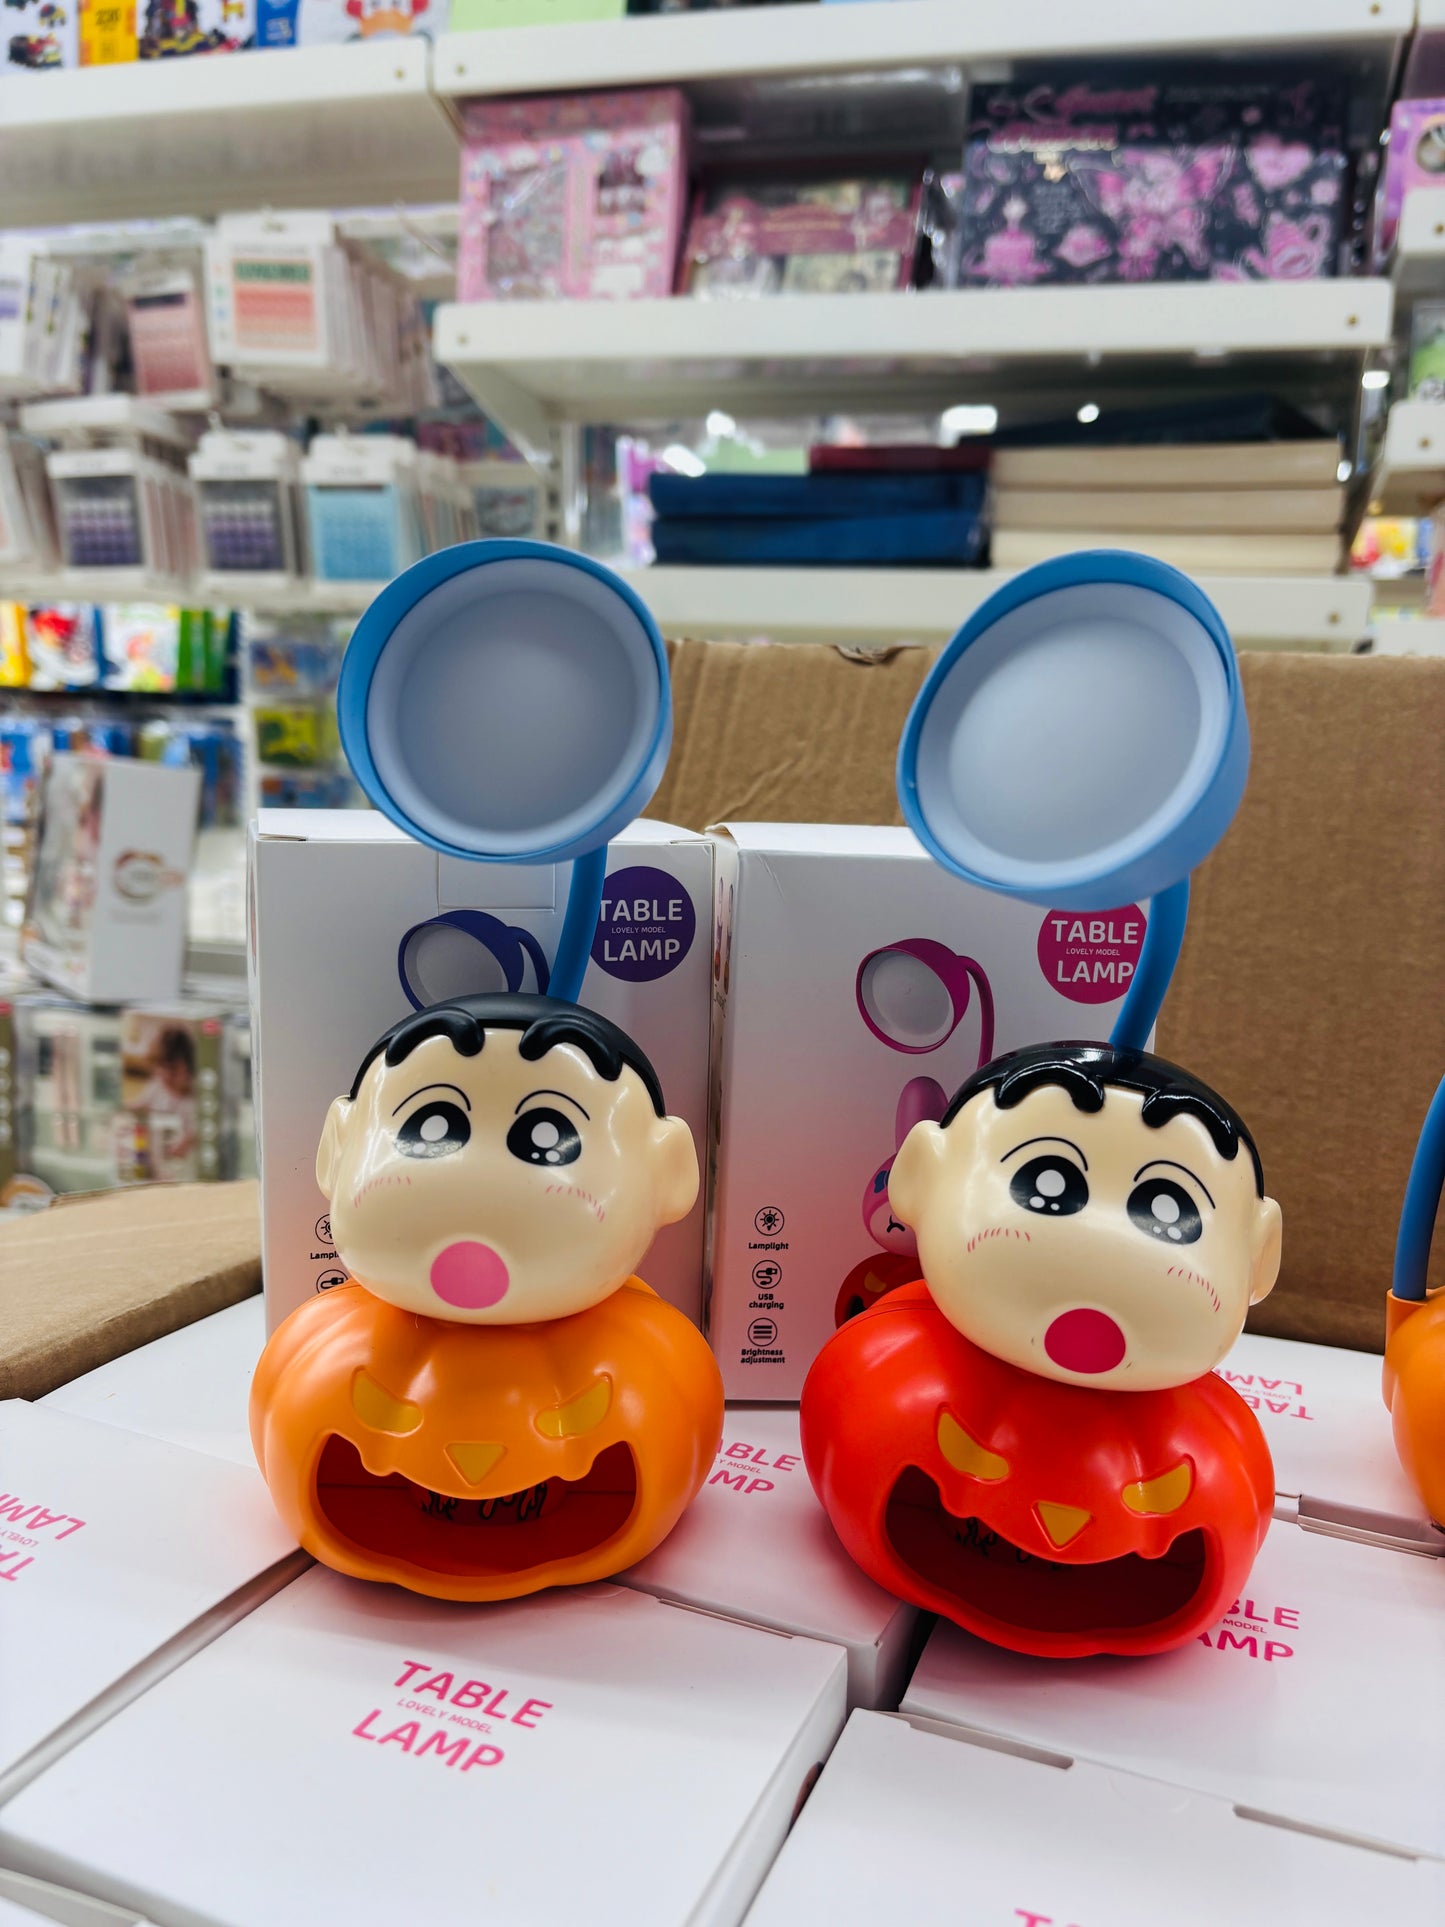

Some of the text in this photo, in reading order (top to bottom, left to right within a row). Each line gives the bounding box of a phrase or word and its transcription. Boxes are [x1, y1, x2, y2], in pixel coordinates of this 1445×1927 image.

[600, 899, 683, 921] TABLE
[1051, 920, 1139, 944] TABLE
[604, 939, 680, 962] LAMP
[1066, 948, 1120, 956] LOVELY MODEL
[1057, 961, 1134, 984] LAMP
[310, 1251, 339, 1260] Lampl
[748, 1242, 789, 1251] Lamplight
[749, 1301, 784, 1310] charging
[740, 1356, 785, 1365] adjustment
[1215, 1369, 1303, 1396] LAM
[1242, 1394, 1314, 1420] TAB
[716, 1439, 802, 1472] BLE
[727, 1461, 762, 1474] MODEL
[708, 1470, 775, 1494] MP
[0, 1494, 86, 1540] LAM
[1222, 1618, 1267, 1633] MODEL
[394, 1659, 553, 1729] TABLE
[397, 1697, 492, 1734] LOVELY MODEL
[352, 1708, 505, 1772] LAMP
